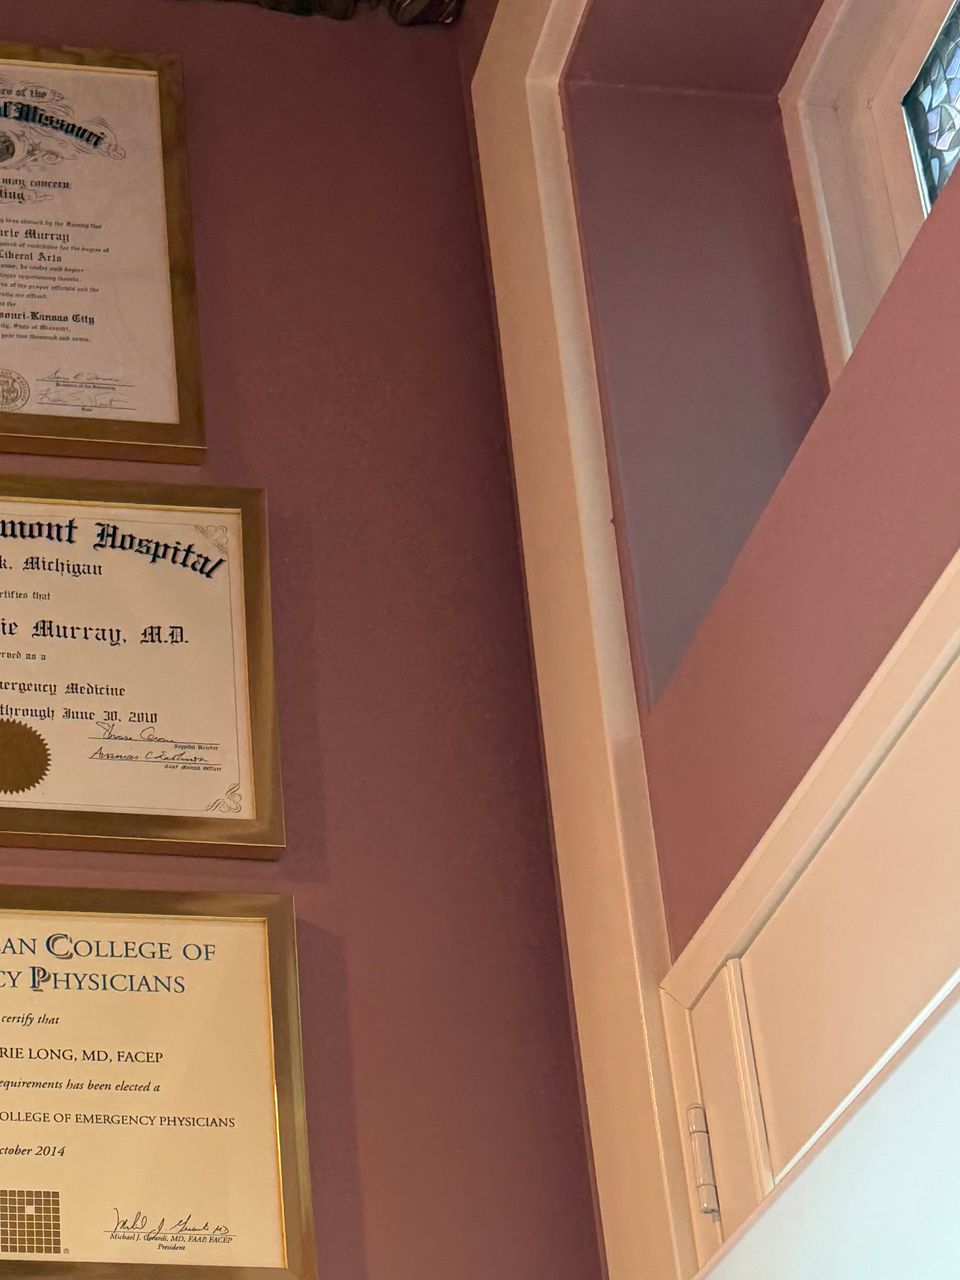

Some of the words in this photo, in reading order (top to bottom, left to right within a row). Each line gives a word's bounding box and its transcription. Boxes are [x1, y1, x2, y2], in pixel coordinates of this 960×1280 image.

[12, 100, 105, 147] Missouri
[24, 228, 70, 245] Murray
[72, 313, 96, 326] City
[93, 522, 226, 579] Hospital
[23, 556, 103, 578] Michigan
[32, 591, 51, 601] that
[31, 618, 127, 646] Murray,
[140, 624, 190, 645] M.D.
[64, 682, 125, 697] Medicine
[0, 703, 55, 721] through
[62, 707, 96, 721] June
[128, 711, 158, 724] 2010
[45, 933, 173, 960] COLLEGE
[182, 943, 216, 961] OF
[29, 966, 186, 994] PHYSICIANS
[1, 1012, 34, 1027] certify
[37, 1014, 60, 1025] that
[28, 1048, 78, 1062] LONG,
[82, 1049, 112, 1063] MD,
[117, 1051, 163, 1063] FACEP
[66, 1080, 84, 1090] has
[88, 1081, 112, 1091] been
[115, 1081, 150, 1092] elected
[153, 1084, 160, 1093] a
[53, 1113, 72, 1123] OF
[75, 1113, 157, 1127] EMERGENCY
[160, 1116, 236, 1128] PHYSICIANS
[35, 1146, 66, 1157] 2014
